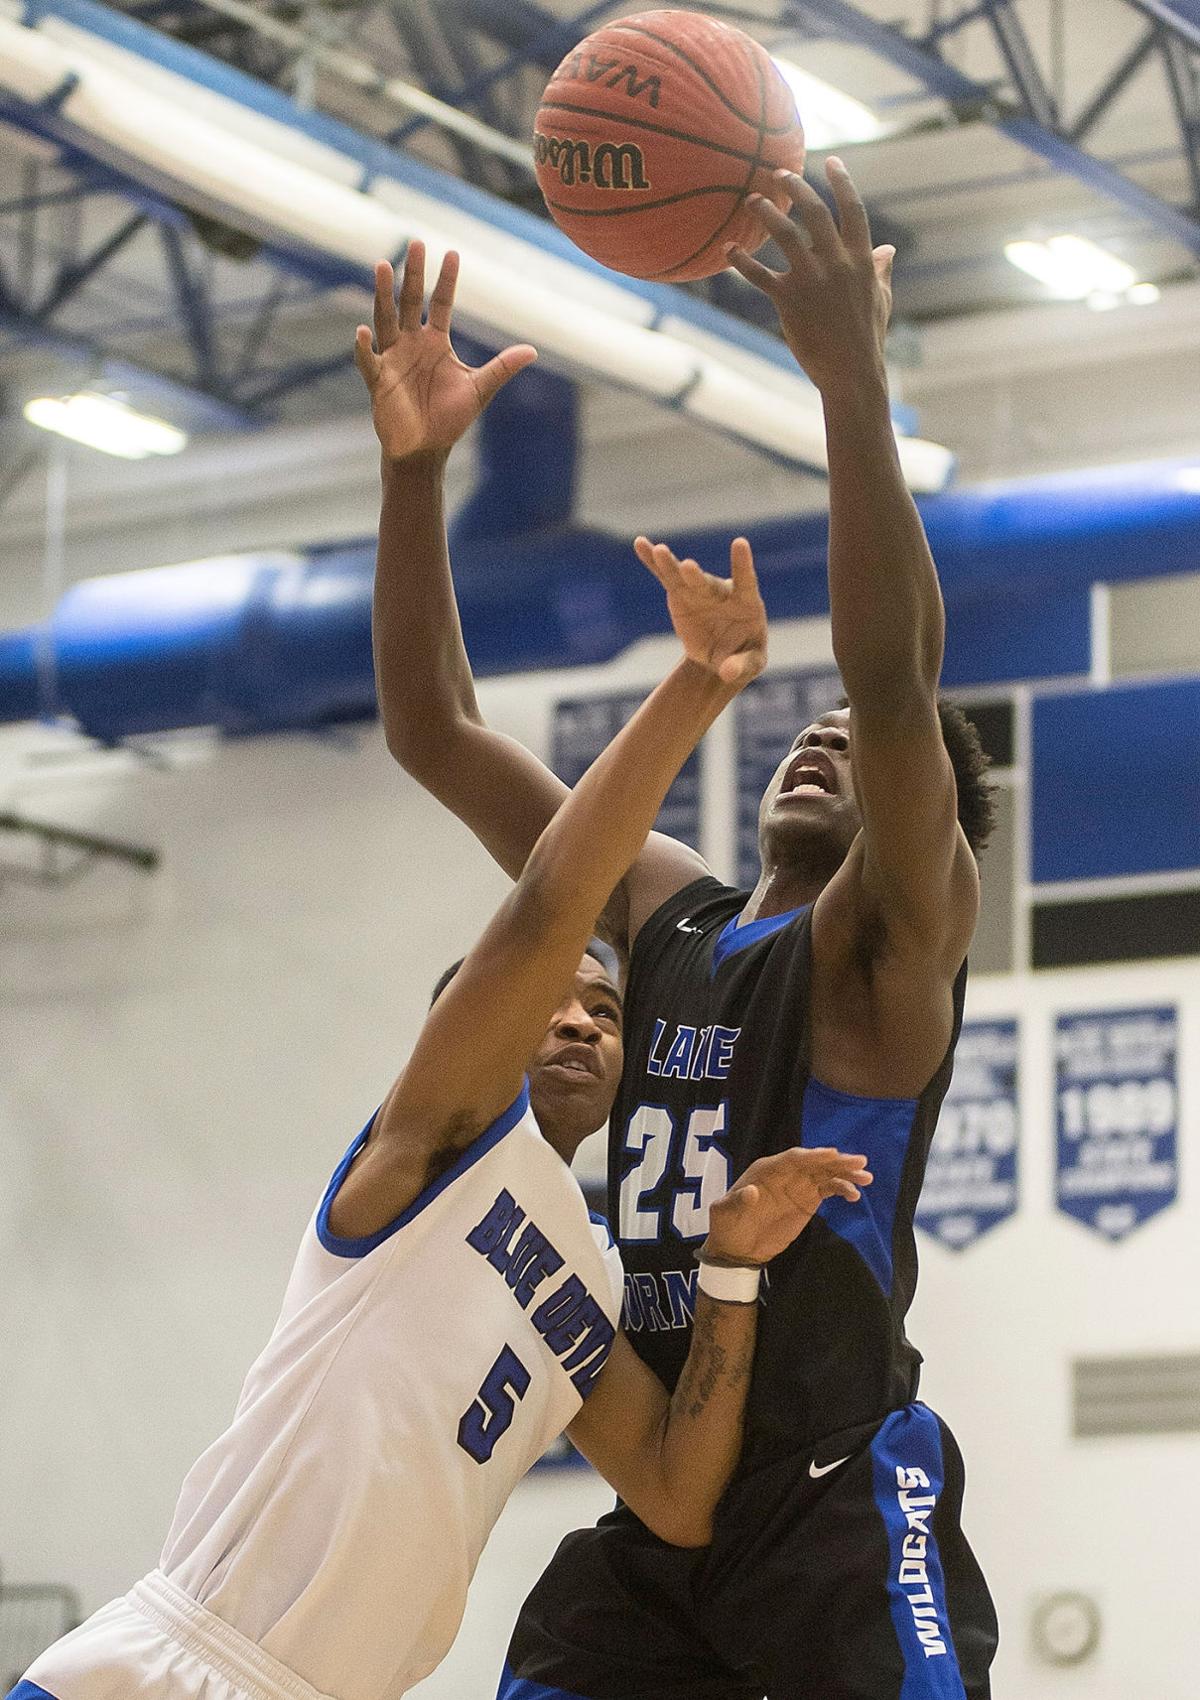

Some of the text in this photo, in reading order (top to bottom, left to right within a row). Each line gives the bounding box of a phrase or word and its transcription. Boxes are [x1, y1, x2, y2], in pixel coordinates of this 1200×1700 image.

[535, 132, 651, 190] Wilso
[616, 1099, 732, 1243] 25
[464, 1186, 566, 1311] BLUE
[456, 1341, 532, 1466] 5
[895, 1465, 948, 1659] WILDCATS
